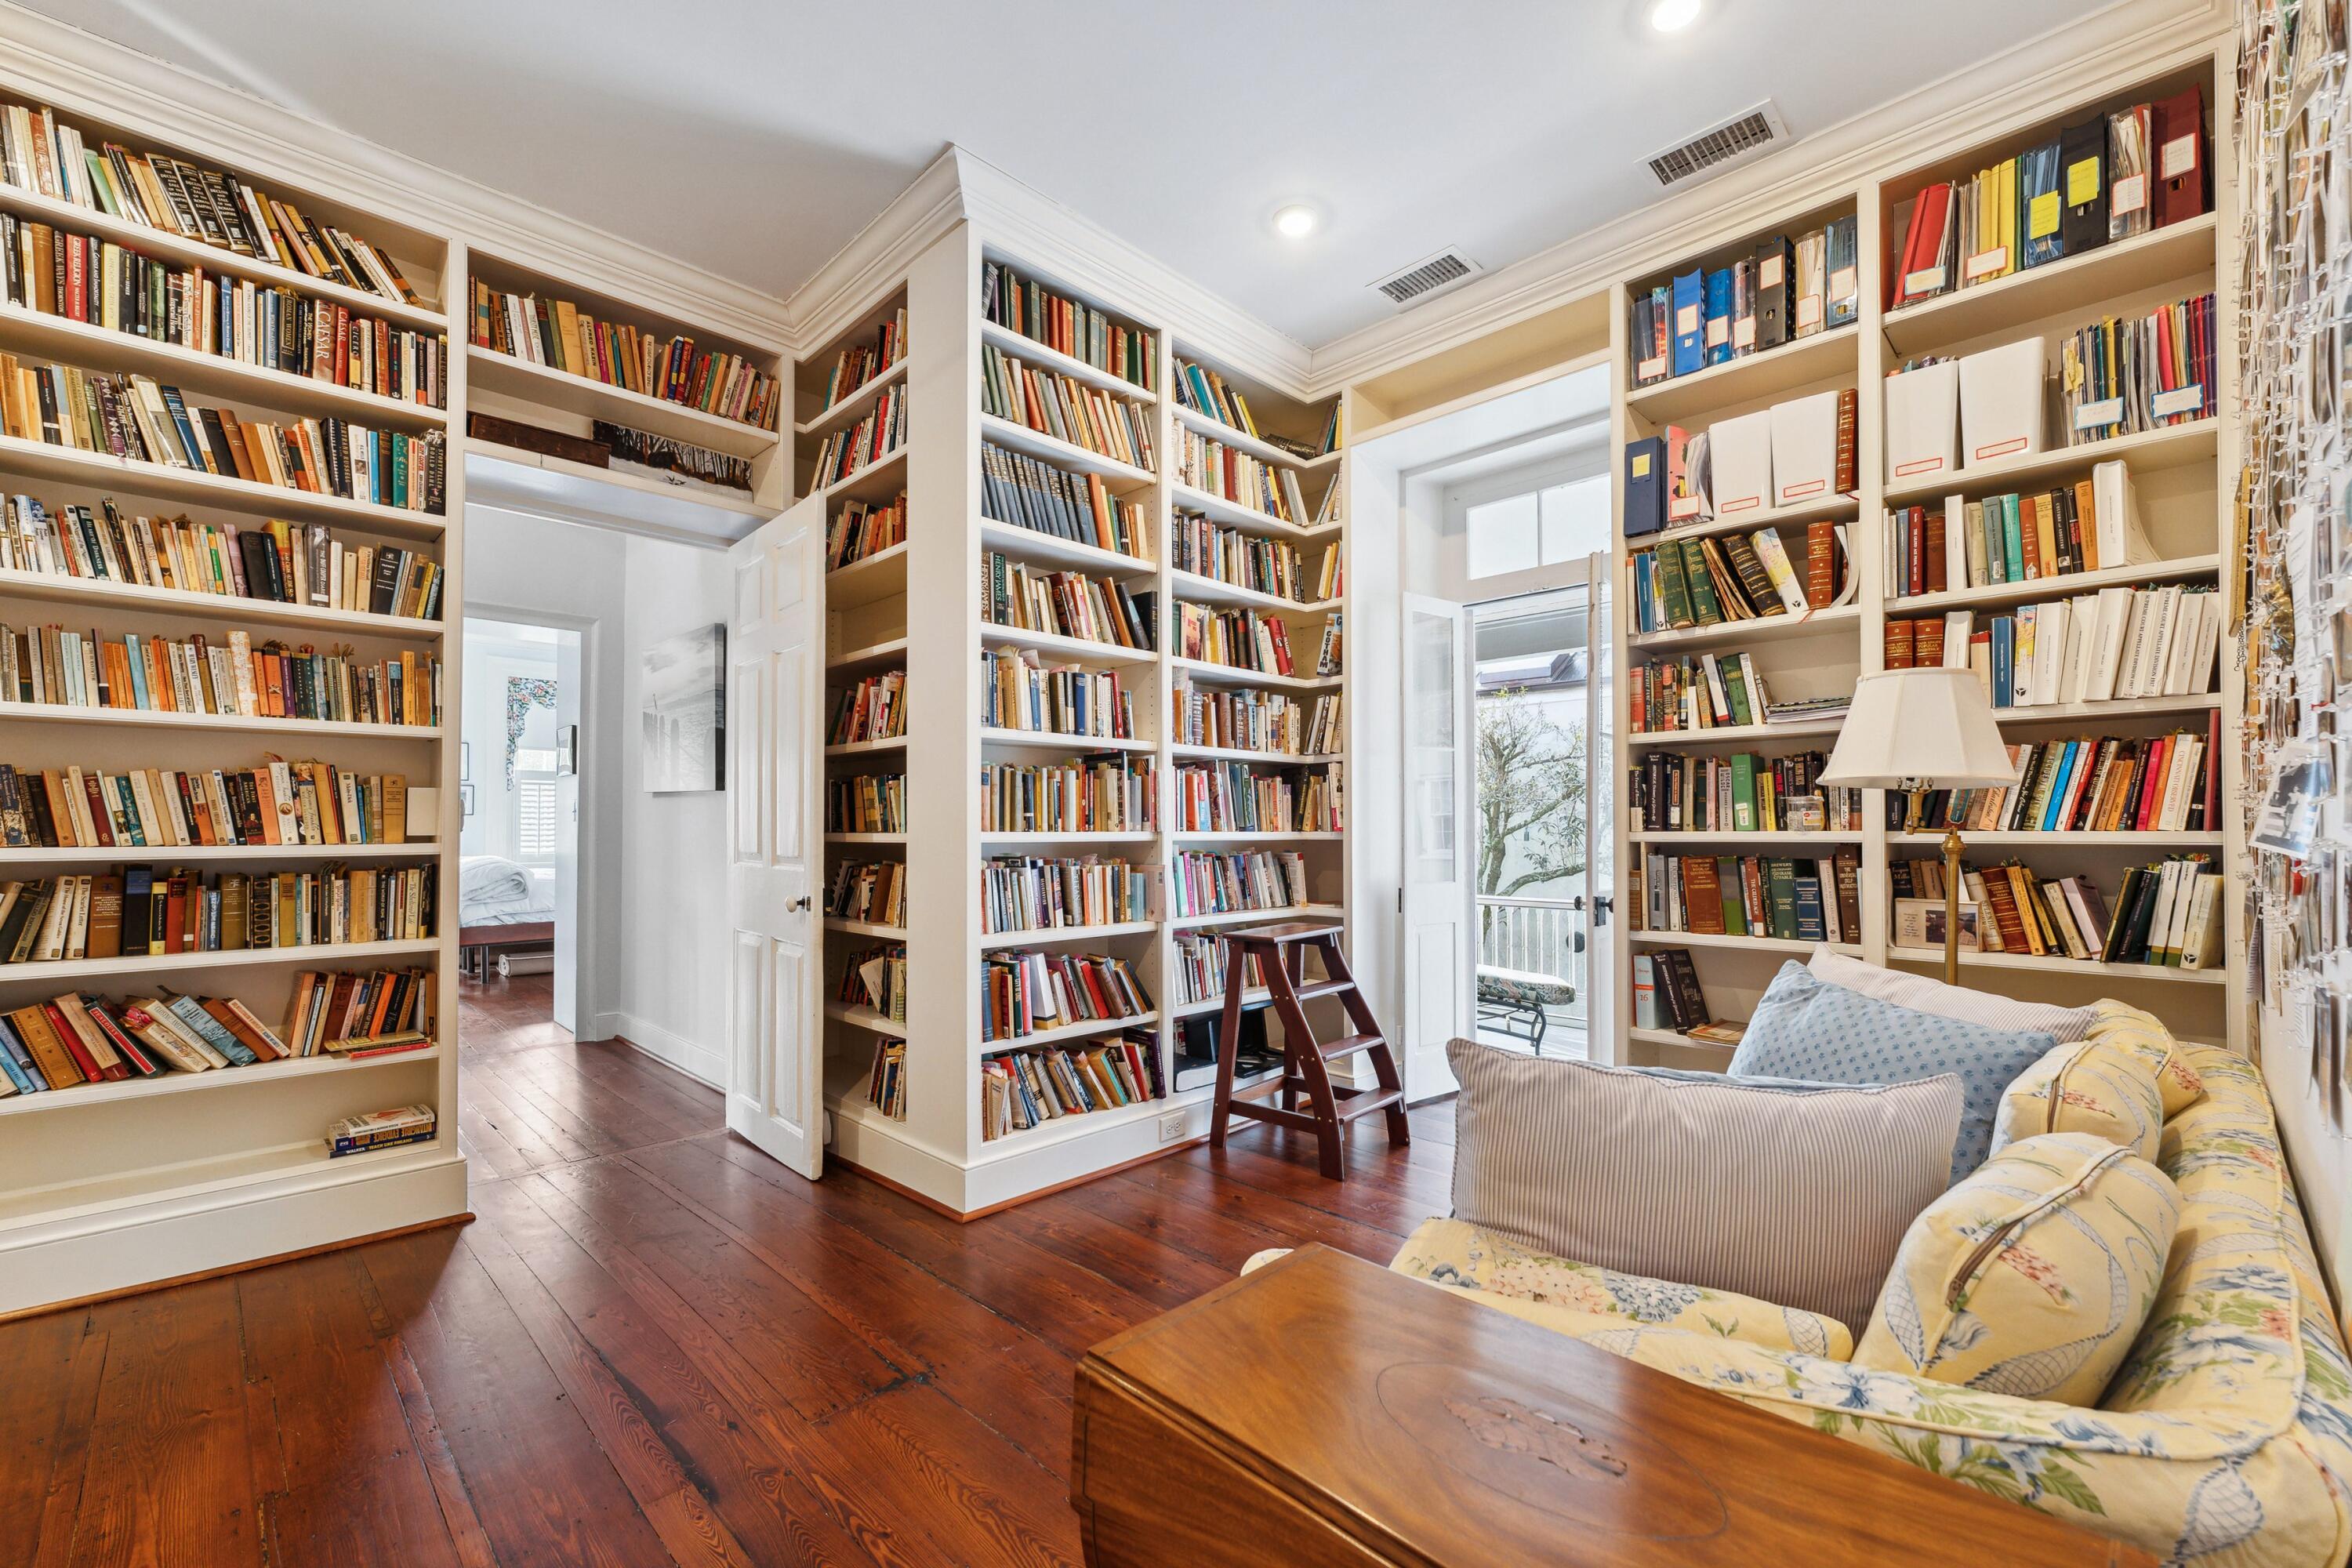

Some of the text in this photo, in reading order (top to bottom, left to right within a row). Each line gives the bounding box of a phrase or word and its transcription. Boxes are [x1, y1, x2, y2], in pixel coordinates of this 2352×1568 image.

[54, 235, 64, 263] GREEK
[56, 264, 65, 285] WAYS
[316, 311, 331, 359] CAESAR
[339, 311, 347, 341] CAESAR
[340, 422, 349, 455] BERTRAND
[93, 546, 103, 569] DARKNESS
[2142, 594, 2151, 615] SUPREME
[2162, 591, 2171, 612] SUPREME
[2159, 613, 2168, 629] COURT
[2134, 633, 2144, 657] APPELLATE
[2155, 630, 2165, 654] APPELLATE
[2130, 658, 2140, 679] DIVISION
[2151, 655, 2161, 676] DIVISION
[2034, 756, 2054, 808] ACCIDENTAL CITY
[2167, 750, 2185, 812] CINCINNATI OBSERVED
[79, 896, 88, 911] Scarlet
